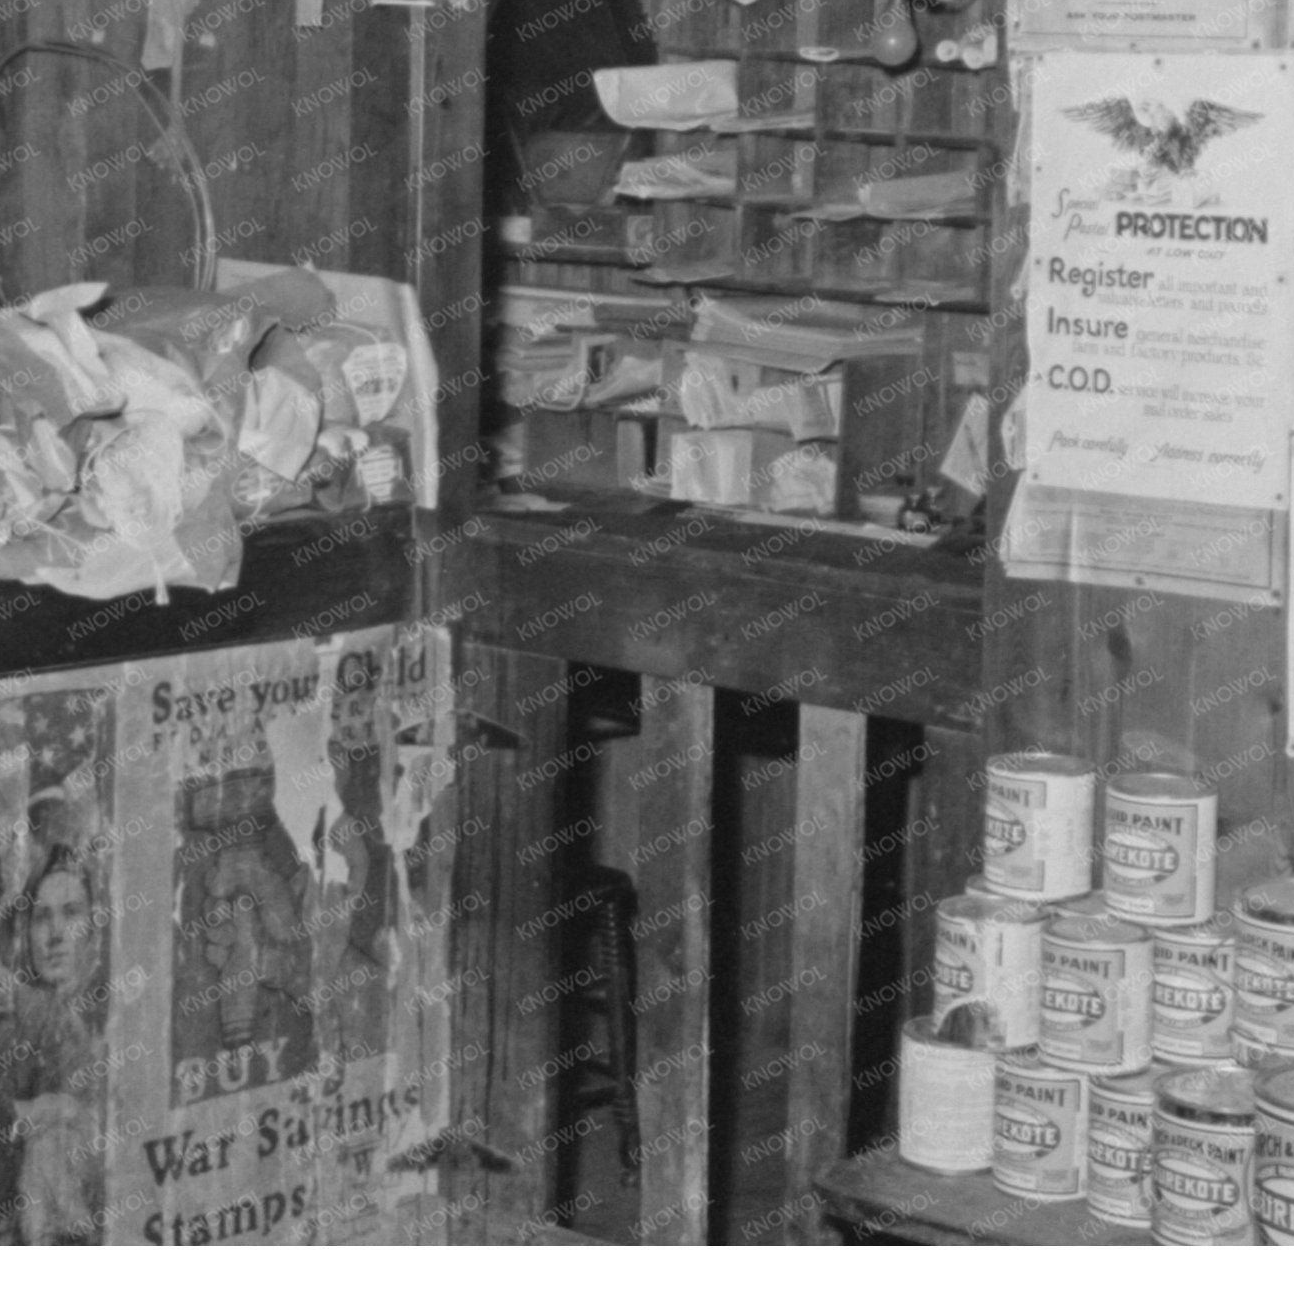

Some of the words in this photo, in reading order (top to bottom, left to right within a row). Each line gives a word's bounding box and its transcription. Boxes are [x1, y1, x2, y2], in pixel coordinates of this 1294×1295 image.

[1115, 211, 1269, 244] PROTECTION
[1048, 256, 1155, 298] Register
[1047, 306, 1129, 339] Insure
[1047, 364, 1115, 395] C.O.D.
[152, 681, 236, 725] Save
[1133, 812, 1184, 836] PAINT
[1060, 956, 1112, 979] PAINT
[1178, 950, 1228, 972] PAINT
[174, 1037, 289, 1108] BUY
[1015, 1082, 1067, 1109] PAINT
[142, 1129, 235, 1187] War
[1206, 1143, 1246, 1165] PAINT
